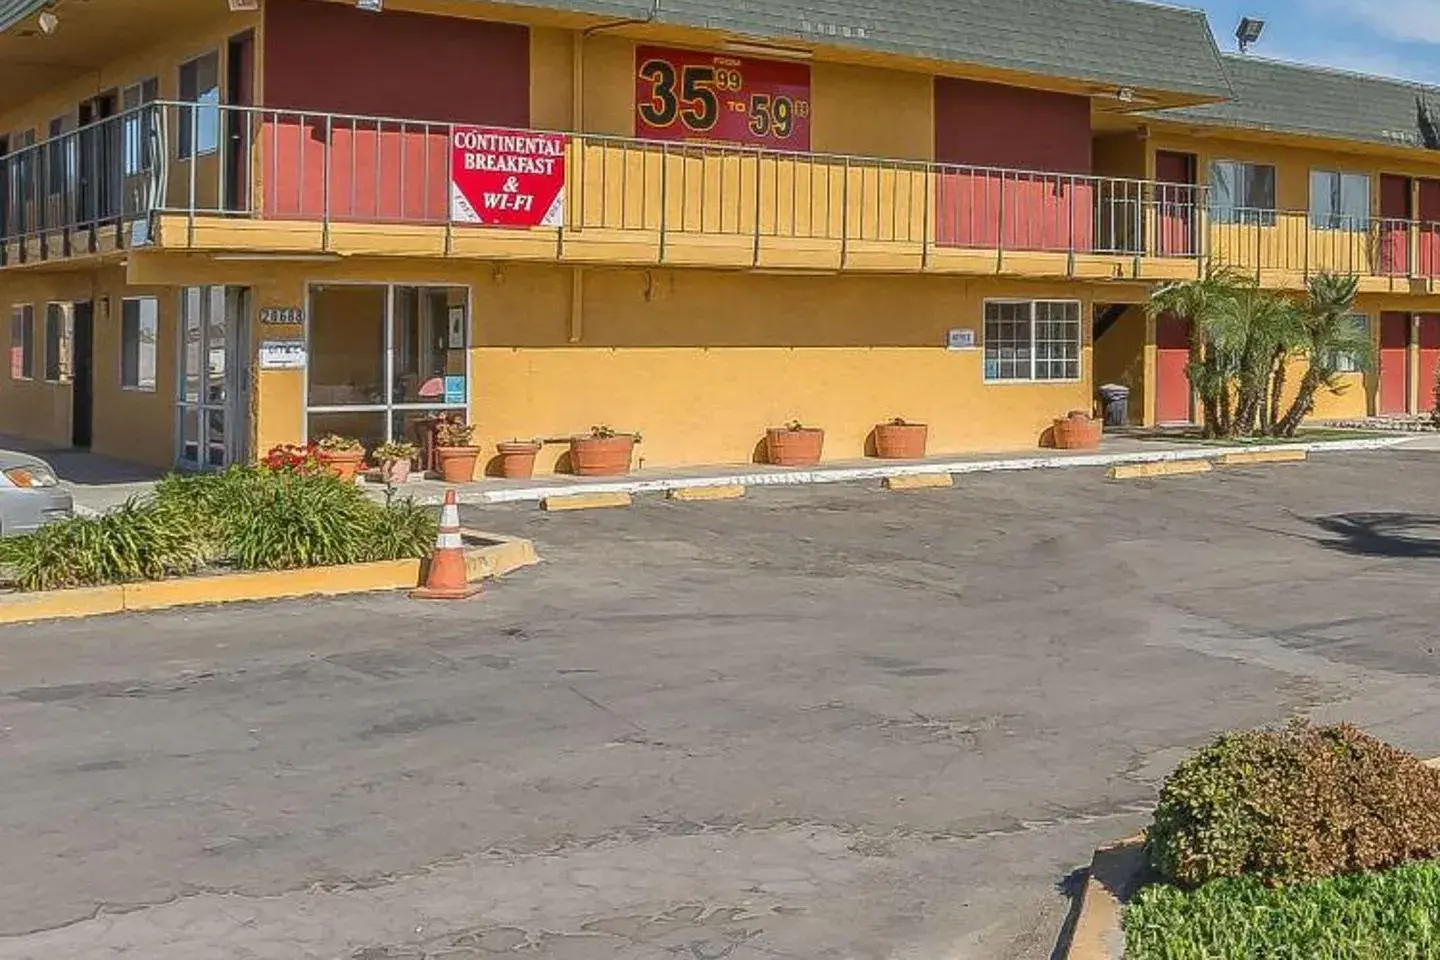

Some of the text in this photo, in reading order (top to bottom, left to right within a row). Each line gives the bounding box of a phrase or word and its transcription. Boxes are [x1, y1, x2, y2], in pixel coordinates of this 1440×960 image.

[727, 100, 746, 113] TO
[749, 93, 794, 139] 59
[454, 132, 565, 157] CONTINENTAL
[464, 152, 555, 175] BREAKFAST
[503, 176, 519, 193] &
[483, 192, 534, 212] WI-FI
